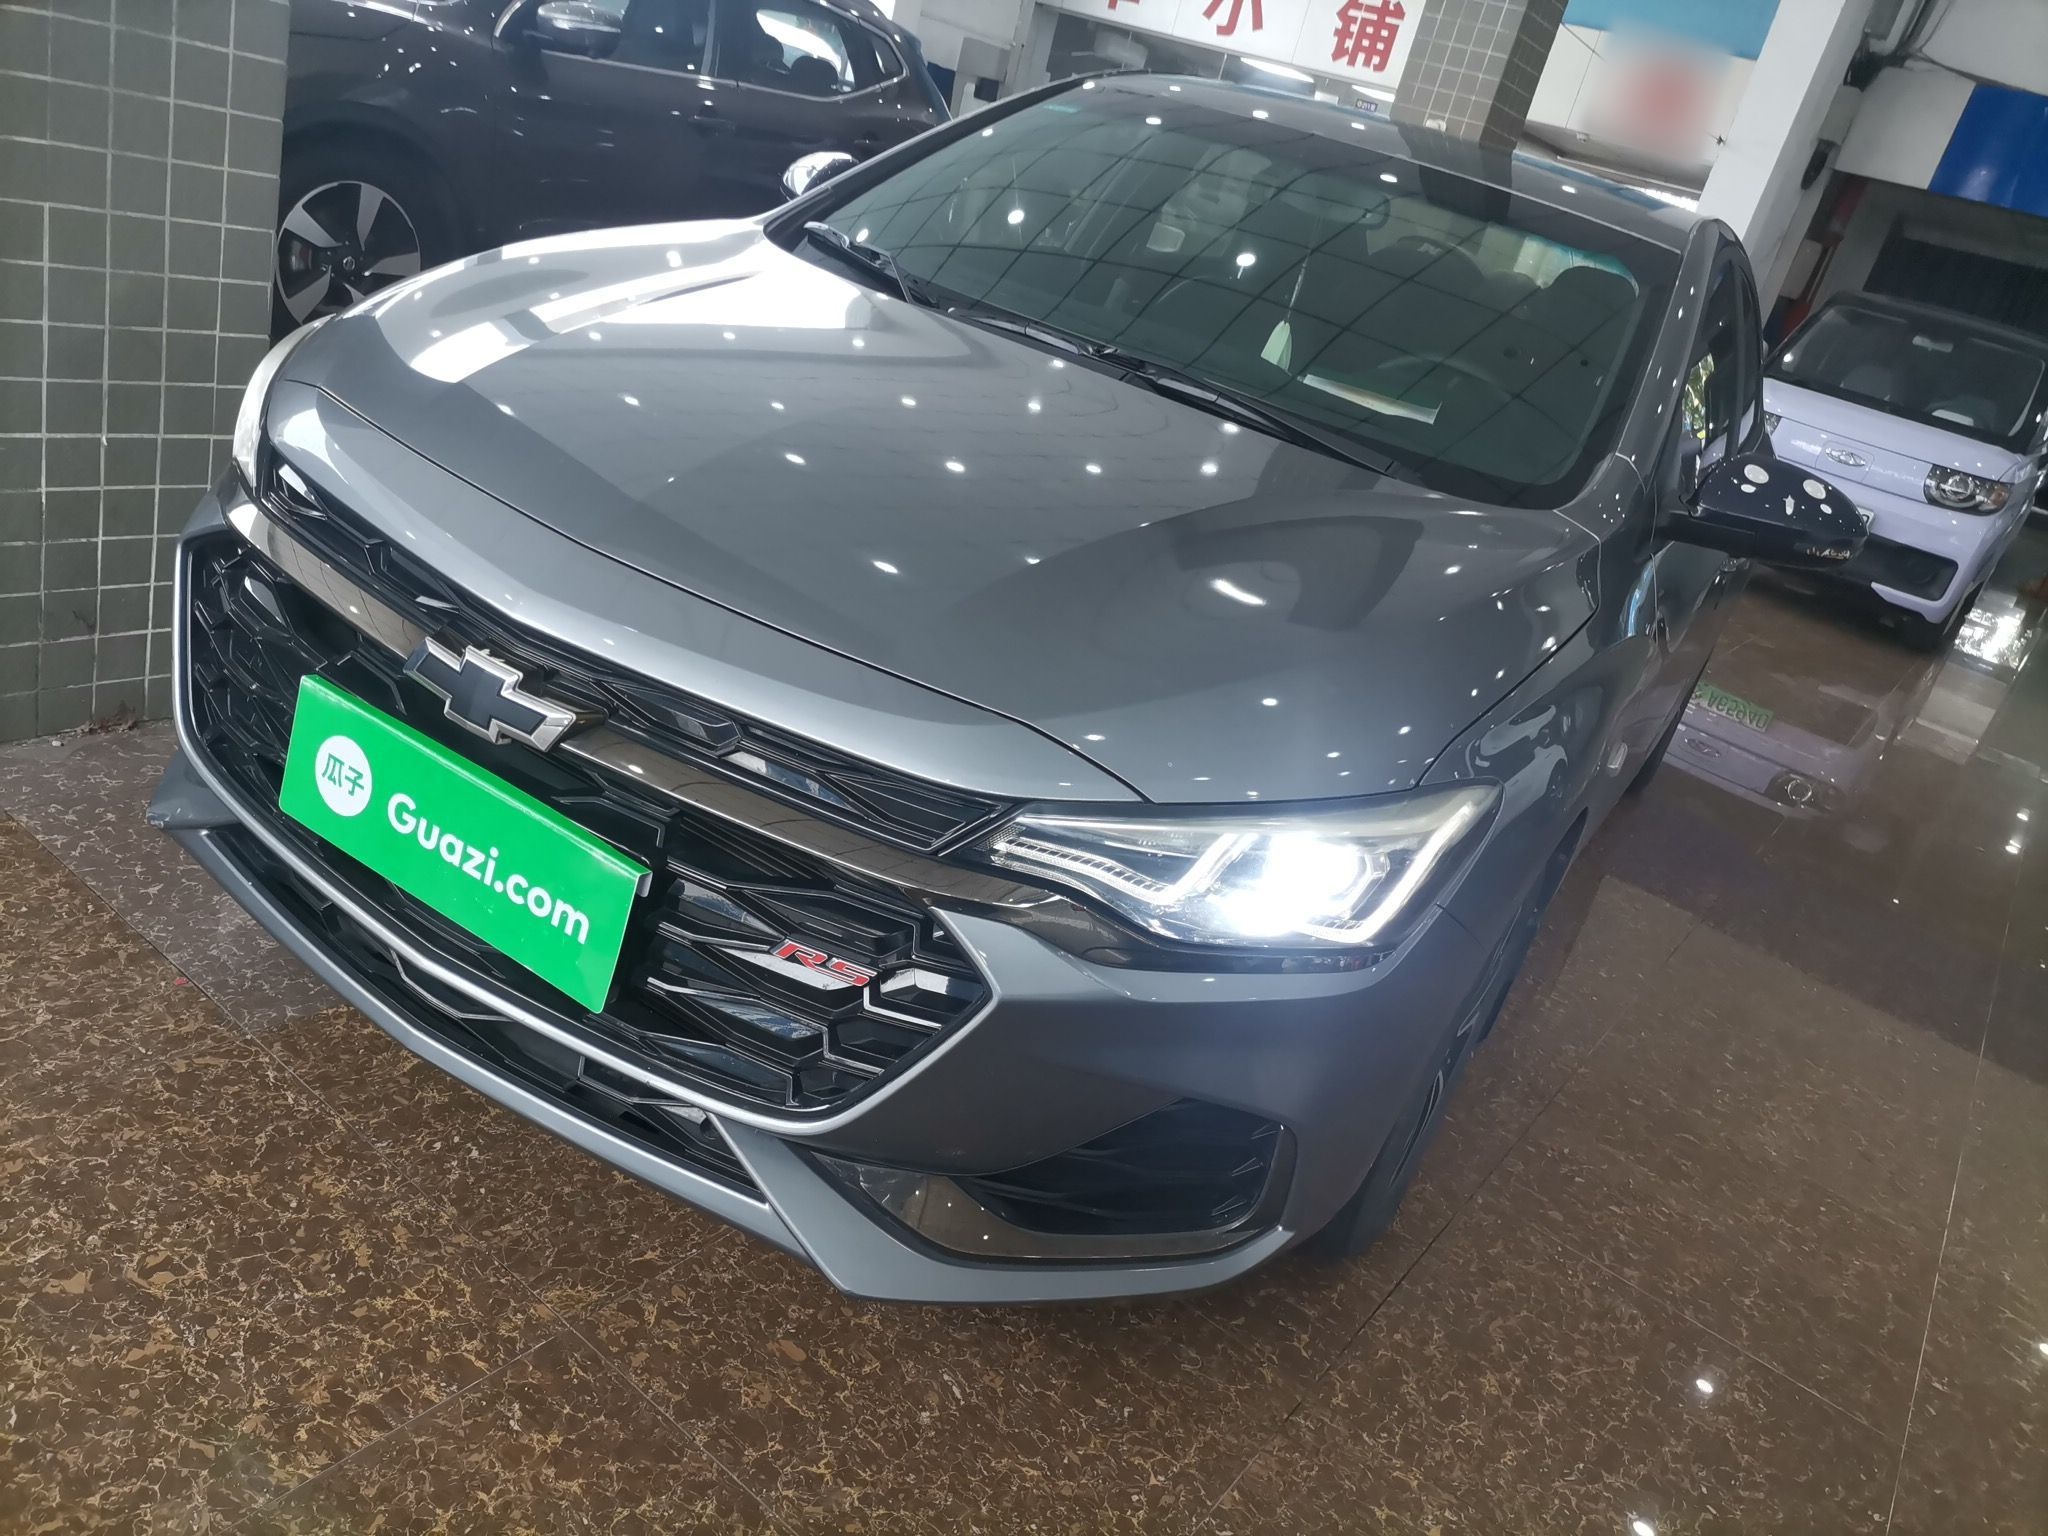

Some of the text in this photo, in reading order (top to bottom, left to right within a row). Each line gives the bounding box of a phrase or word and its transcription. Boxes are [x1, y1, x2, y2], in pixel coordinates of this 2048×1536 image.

[1107, 0, 1405, 72] 小铺
[321, 752, 365, 797] 瓜子
[387, 792, 590, 945] Guazi.com
[769, 938, 878, 987] RS
